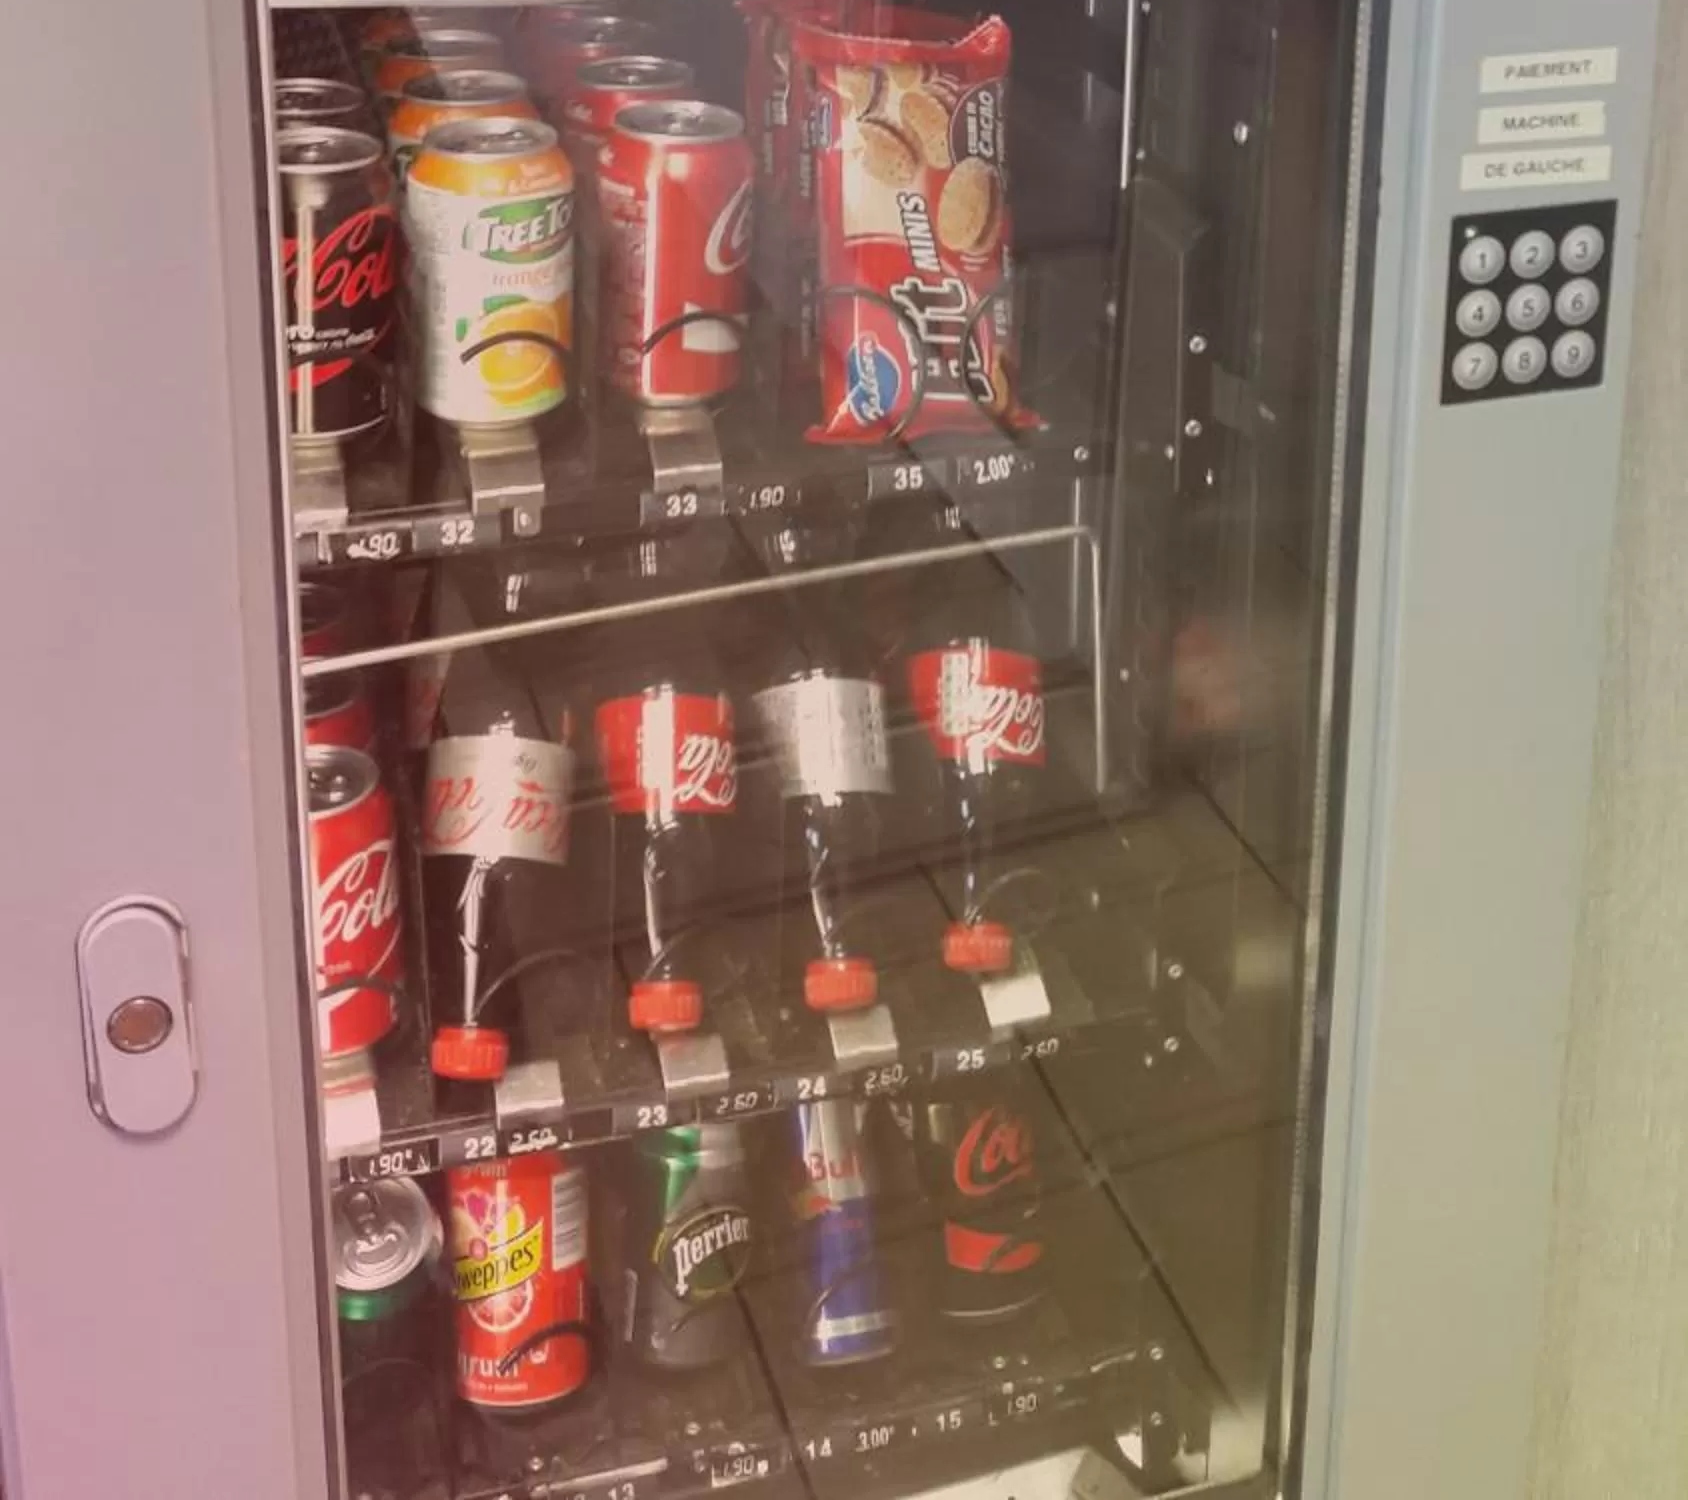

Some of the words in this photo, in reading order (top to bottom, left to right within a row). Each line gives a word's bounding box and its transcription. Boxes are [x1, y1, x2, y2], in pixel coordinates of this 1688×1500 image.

[1503, 59, 1592, 80] PAIEMENT
[1502, 112, 1581, 132] MACHINE
[1484, 161, 1507, 179] DE
[1512, 157, 1586, 177] GAUCHE
[899, 192, 941, 273] MINIS
[1525, 246, 1540, 265] 2
[1576, 240, 1588, 260] 3
[1472, 305, 1484, 322] 4
[1523, 298, 1534, 317] 5
[1572, 292, 1584, 311] 6
[1469, 357, 1481, 376] 7
[1519, 351, 1531, 370] 8
[1568, 345, 1580, 365] 9
[894, 466, 923, 490] 35
[666, 492, 697, 518] 33
[441, 518, 474, 546] 32
[956, 1049, 985, 1072] 25
[797, 1076, 827, 1099] 24
[637, 1104, 668, 1128] 23
[464, 1135, 497, 1160] 22
[936, 1409, 961, 1432] 15
[805, 1435, 832, 1460] 14
